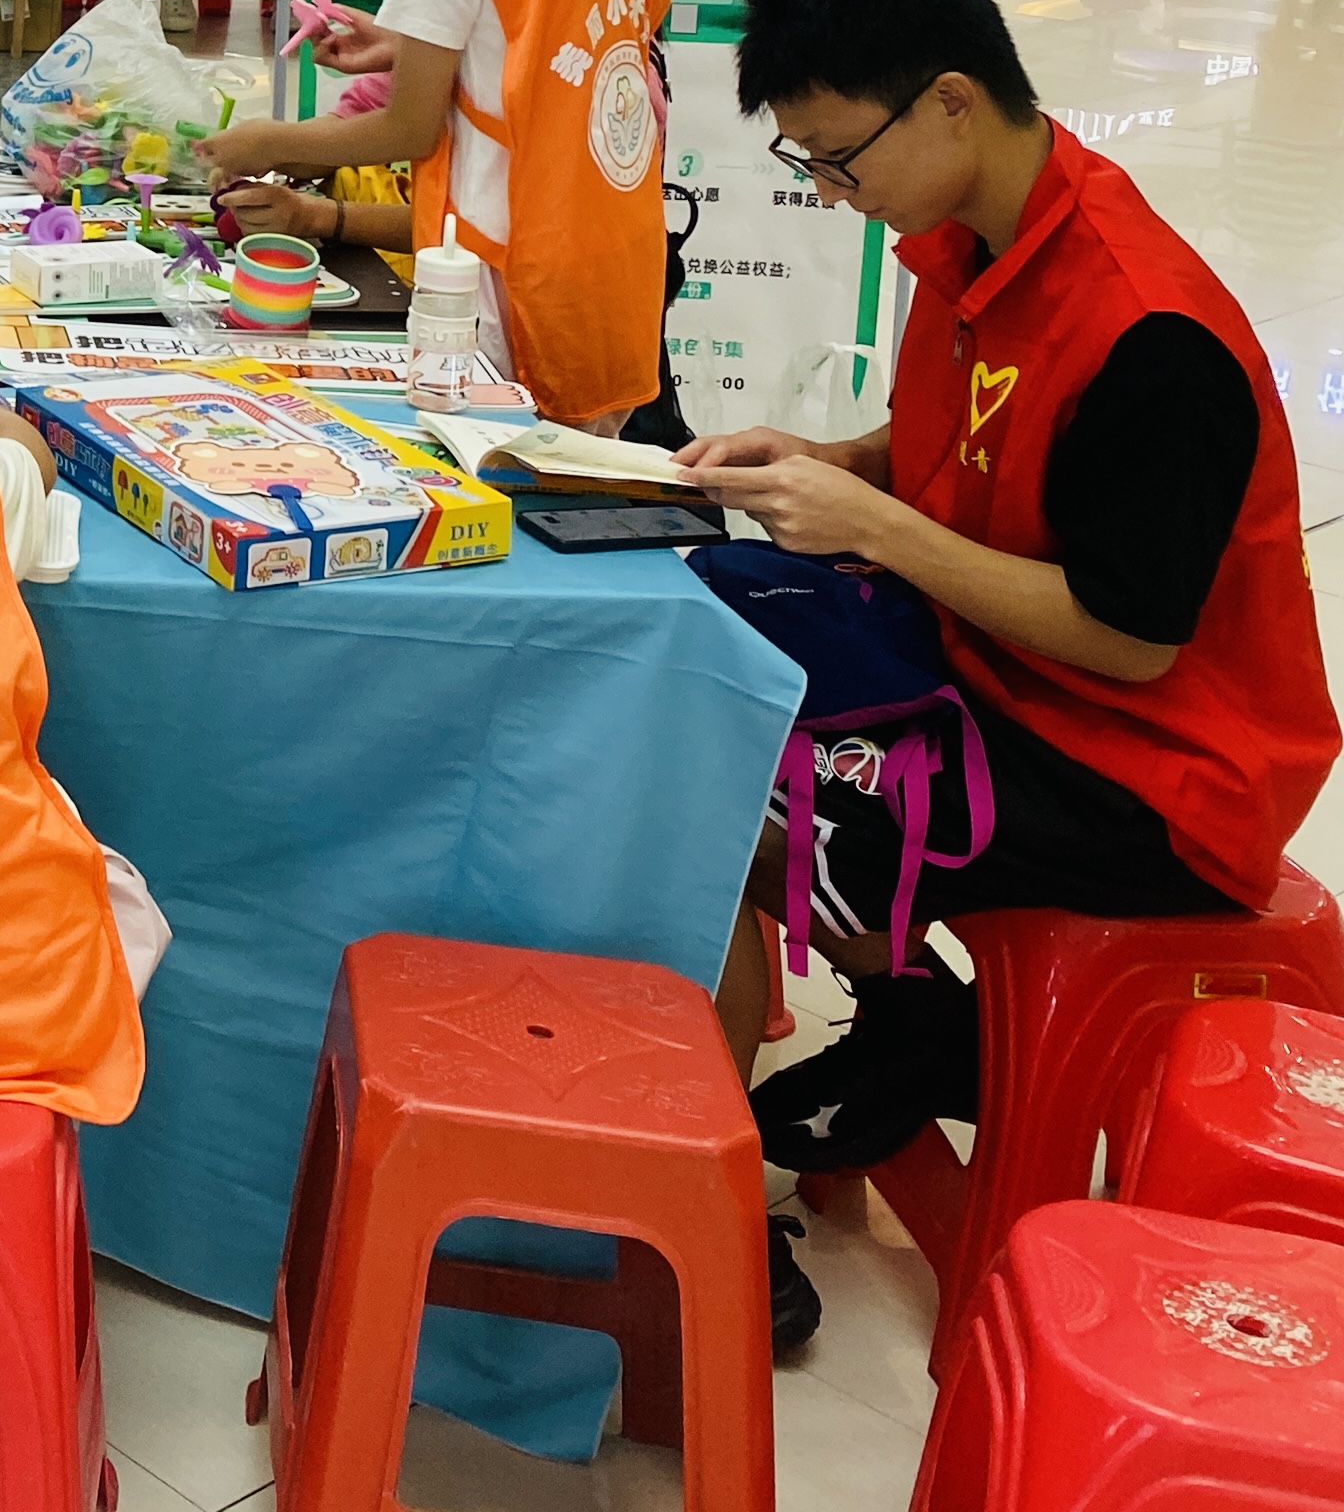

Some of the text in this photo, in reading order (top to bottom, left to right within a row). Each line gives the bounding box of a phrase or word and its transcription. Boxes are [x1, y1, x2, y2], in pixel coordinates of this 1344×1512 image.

[678, 155, 694, 177] 3
[682, 258, 791, 279] 兑换公益权益；
[450, 521, 491, 542] DIY
